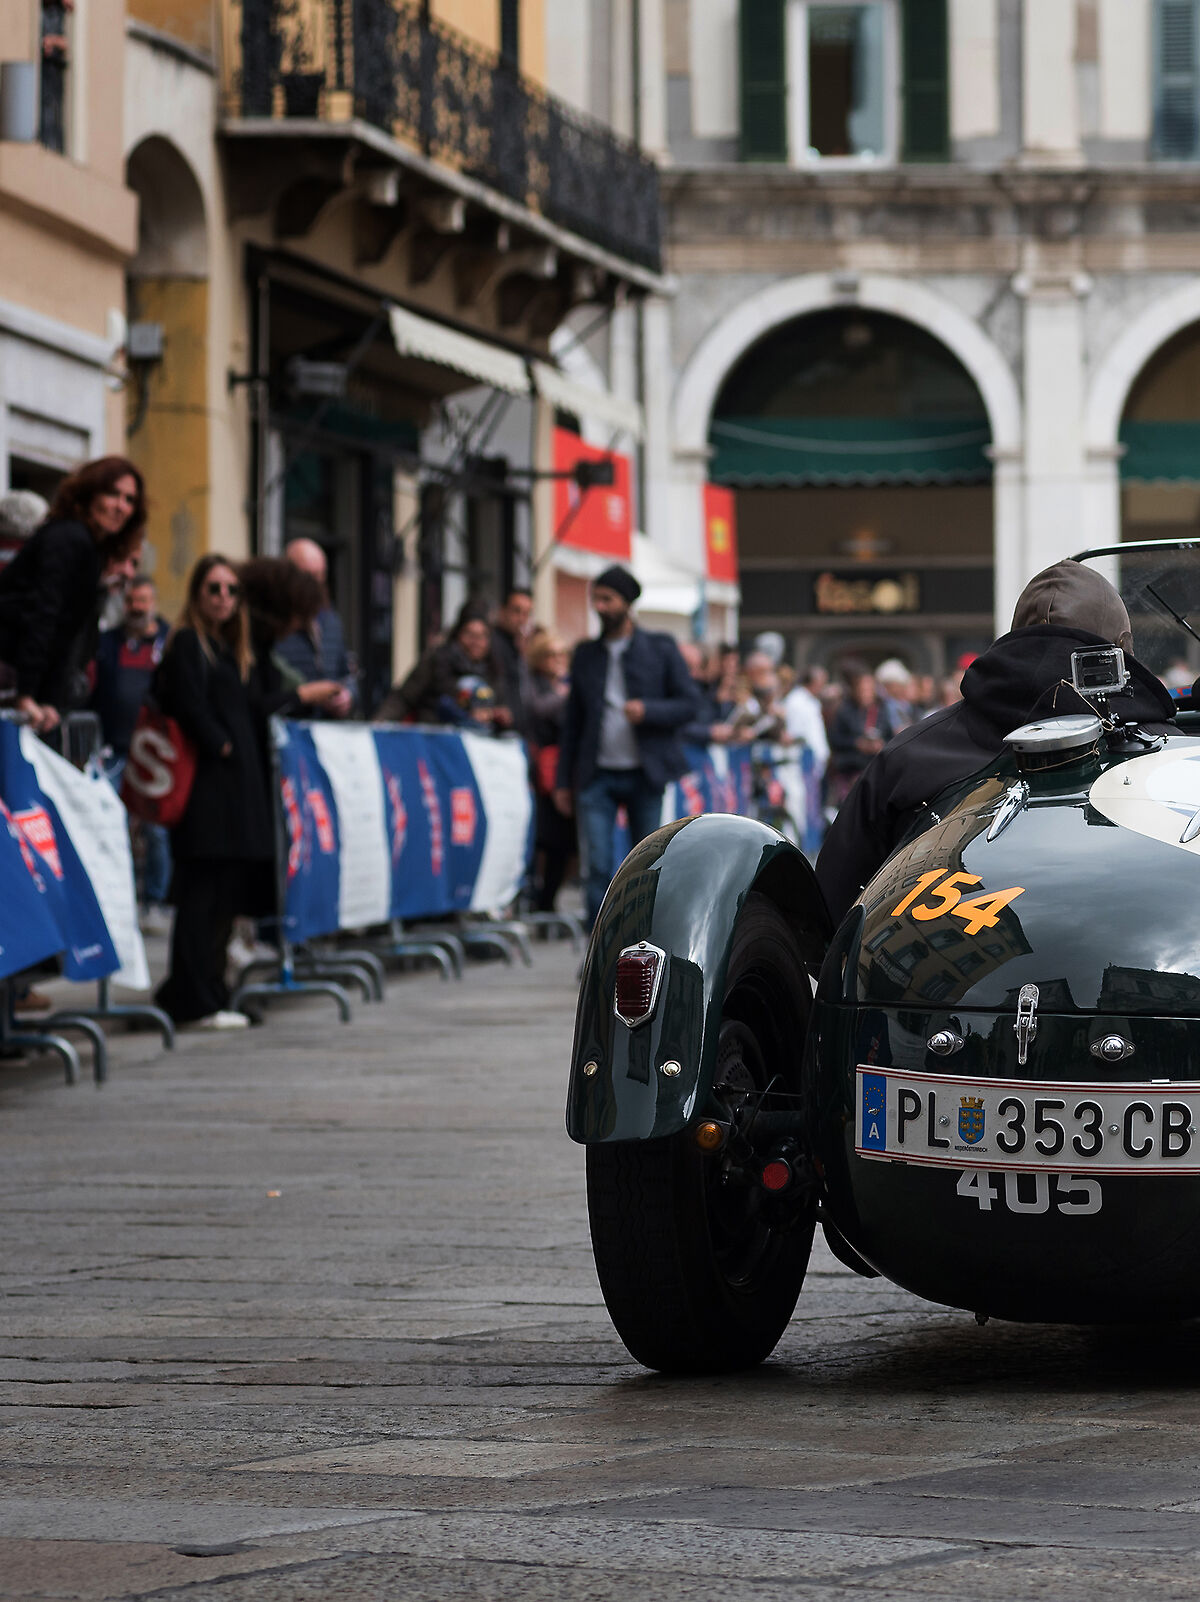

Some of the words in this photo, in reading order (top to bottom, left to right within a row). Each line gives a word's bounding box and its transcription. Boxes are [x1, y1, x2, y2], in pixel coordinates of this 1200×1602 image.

[125, 727, 177, 798] S
[891, 868, 1026, 936] 154
[868, 1122, 880, 1140] A
[898, 1088, 950, 1148] PL
[996, 1097, 1104, 1157] 353
[1122, 1101, 1192, 1158] CB
[956, 1169, 1102, 1215] 405
